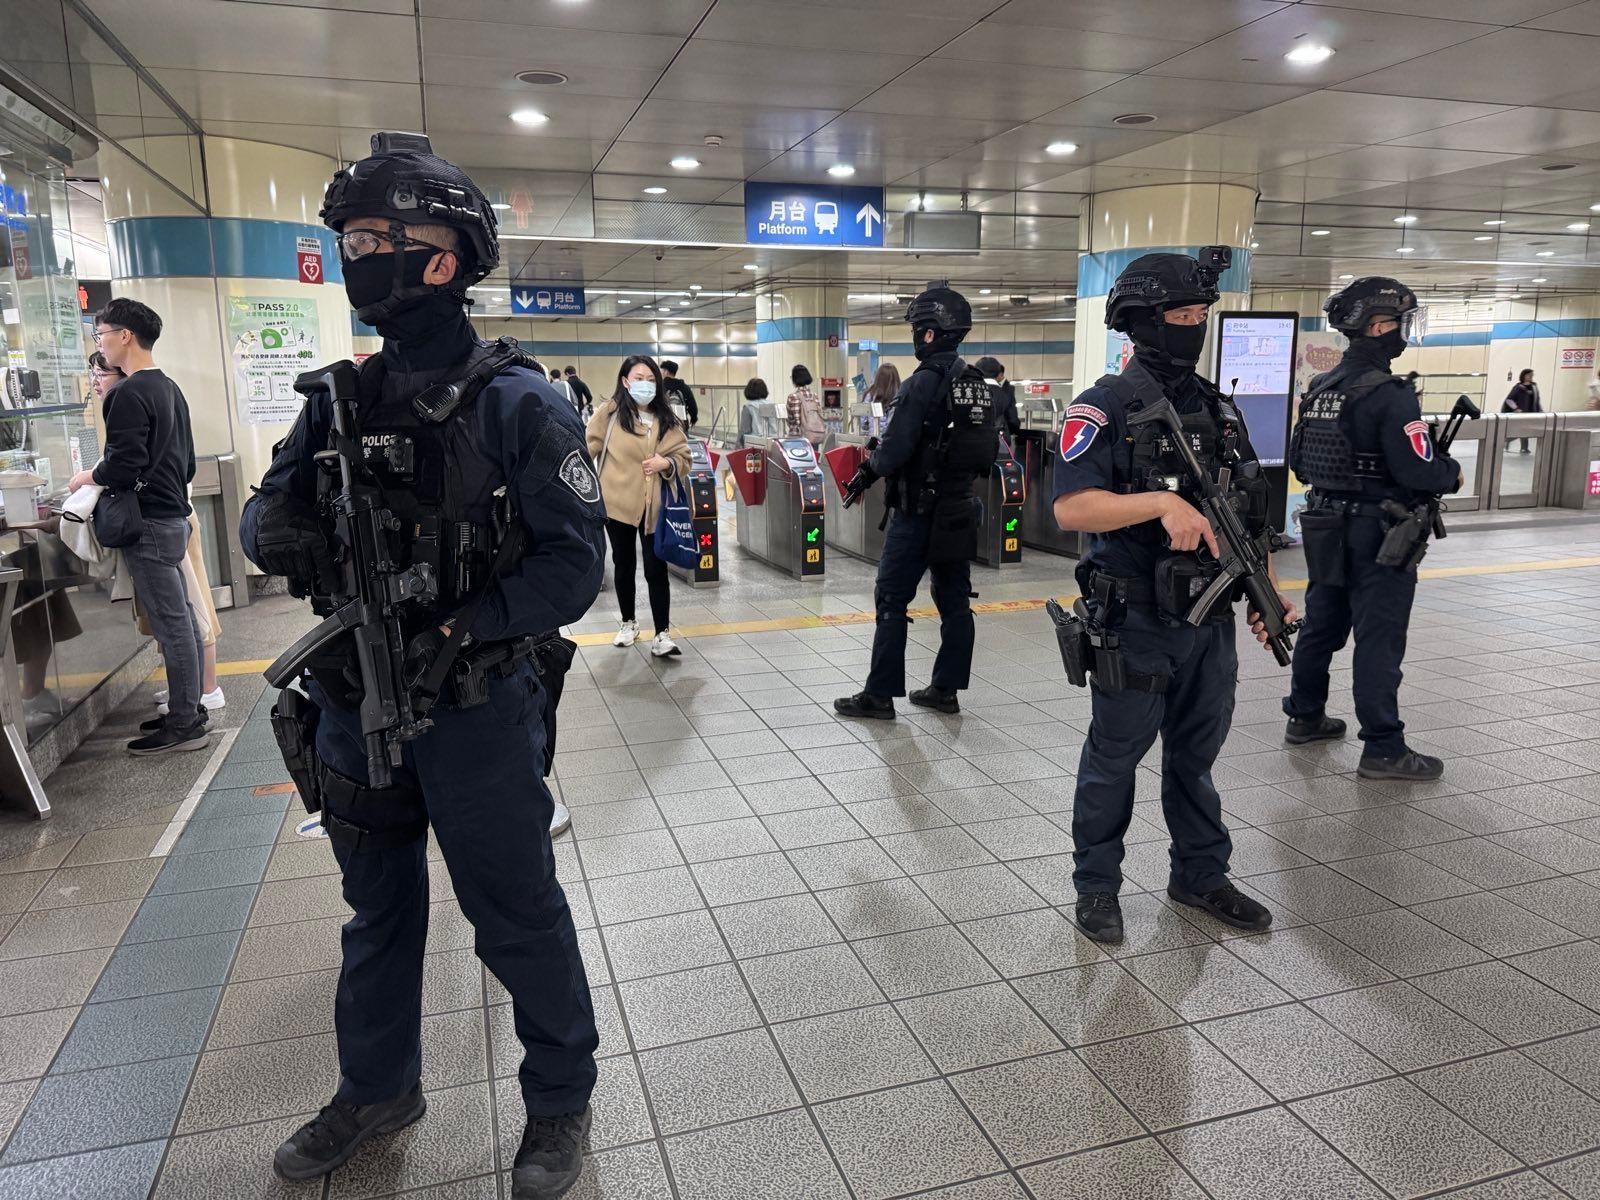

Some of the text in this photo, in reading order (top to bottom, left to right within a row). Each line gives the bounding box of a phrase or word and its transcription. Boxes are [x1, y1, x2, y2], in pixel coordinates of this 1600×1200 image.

[768, 200, 806, 221] 月台
[758, 222, 808, 235] Platform
[554, 292, 574, 302] 月台
